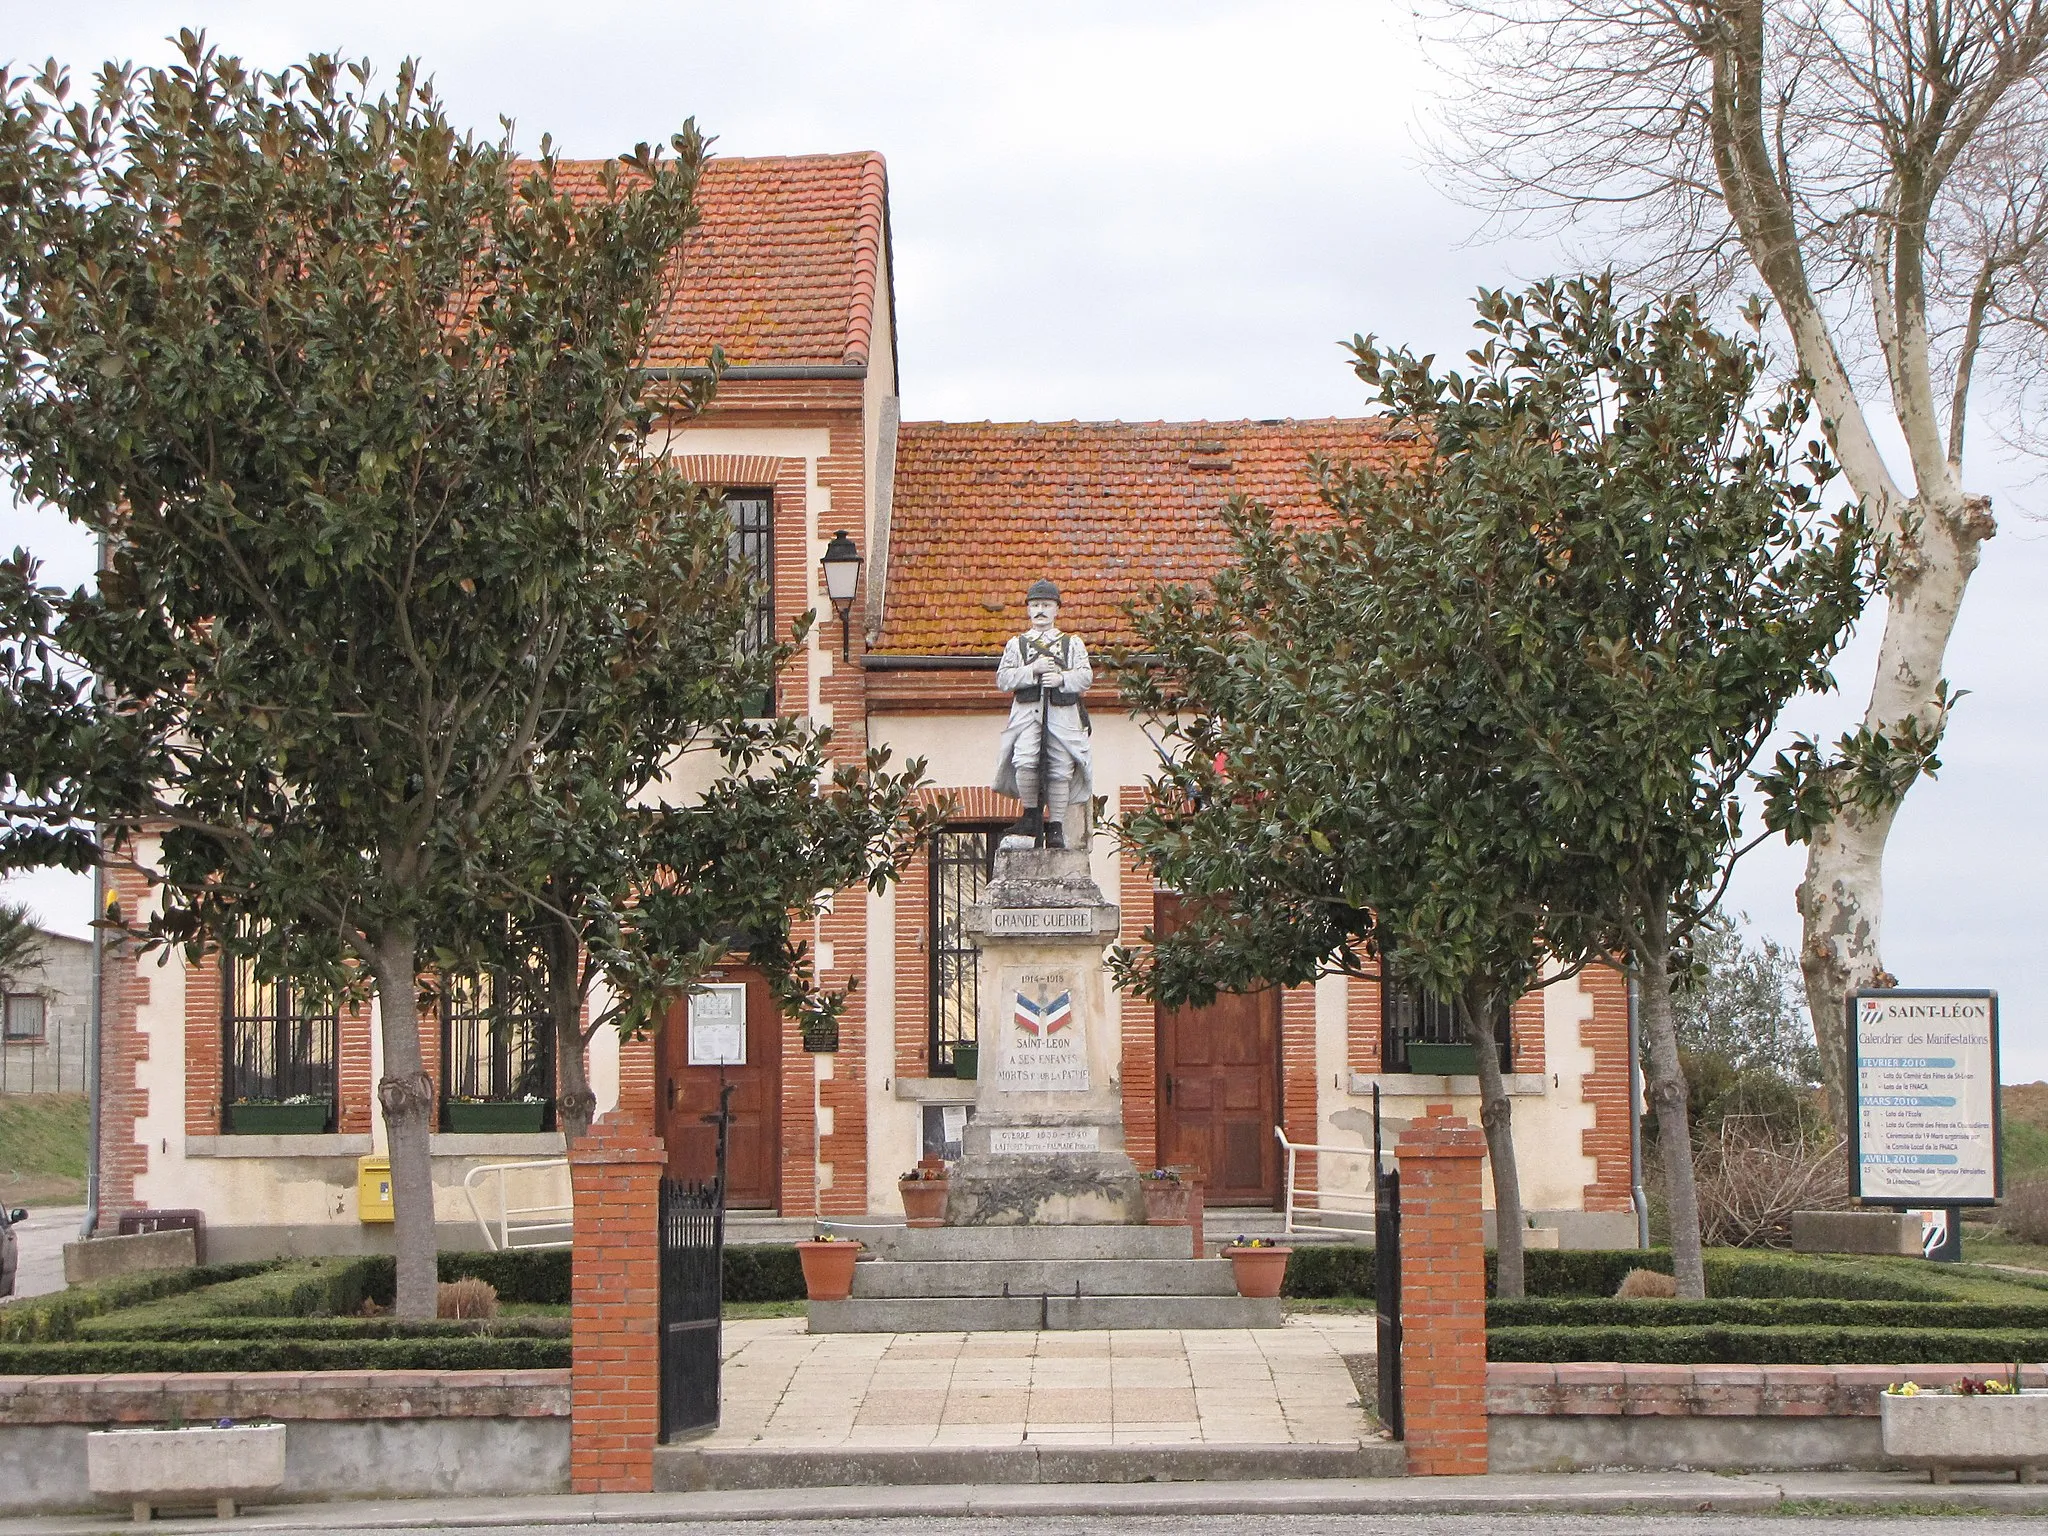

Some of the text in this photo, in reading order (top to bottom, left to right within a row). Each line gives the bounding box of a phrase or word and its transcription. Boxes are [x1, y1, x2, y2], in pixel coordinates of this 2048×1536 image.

[994, 914, 1089, 927] GRANDE GUERRE
[1888, 1003, 1985, 1019] SAINT-LÉON
[1016, 1038, 1070, 1049] SAINT-LEON
[1858, 1032, 1988, 1045] Calendrier des Manifestations
[1009, 1055, 1077, 1065] A SES ENFANTS
[1862, 1058, 1926, 1067] FEVRIER 2010
[998, 1070, 1029, 1080] MORTS
[1863, 1096, 1918, 1106] MARS 2010
[1863, 1155, 1918, 1163] AVRIL 2010
